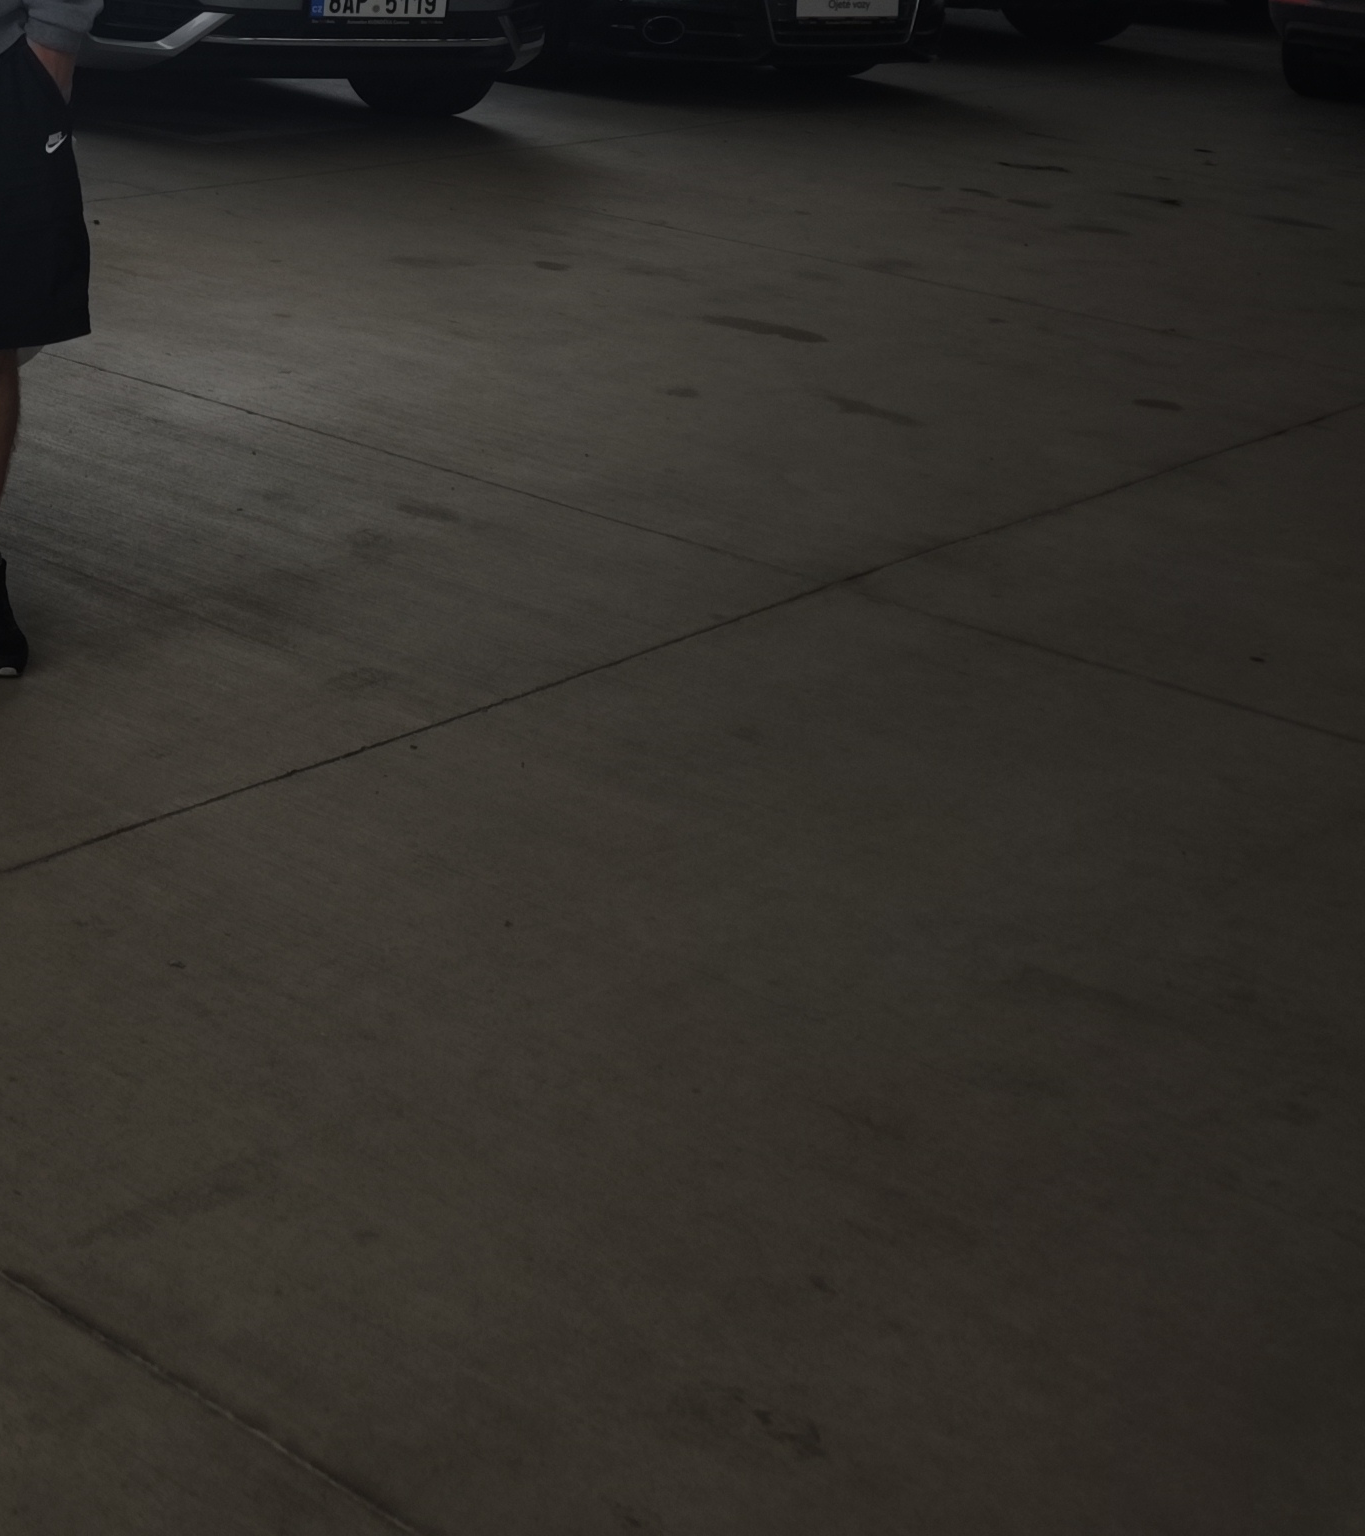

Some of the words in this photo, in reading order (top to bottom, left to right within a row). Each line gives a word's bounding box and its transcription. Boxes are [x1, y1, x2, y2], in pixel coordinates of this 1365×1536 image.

[311, 5, 323, 14] CZ
[828, 0, 851, 11] Ojeté
[852, 1, 871, 11] vozy
